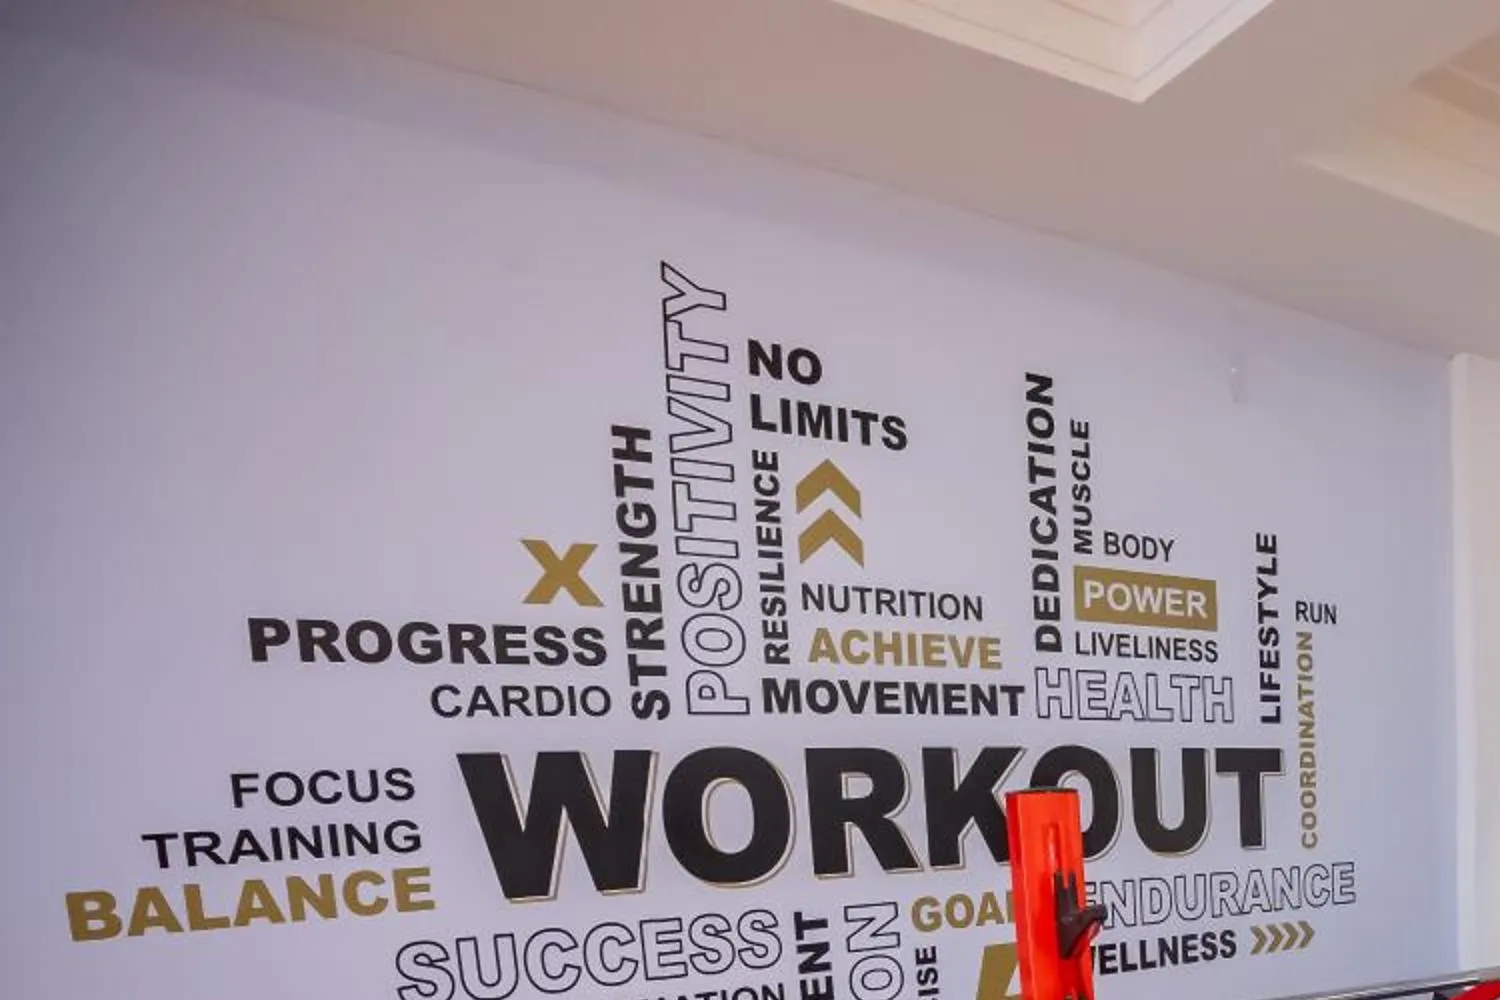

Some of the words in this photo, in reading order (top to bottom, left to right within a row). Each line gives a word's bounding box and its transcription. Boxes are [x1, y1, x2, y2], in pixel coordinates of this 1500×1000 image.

[748, 339, 823, 385] NO
[750, 393, 907, 451] LIMITS
[660, 260, 750, 715] POSITIVITY
[1070, 419, 1093, 555] MUSCLE
[1025, 372, 1063, 653] DEDICATION
[751, 449, 792, 665] RESILIENCE
[1104, 531, 1175, 562] BODY
[611, 424, 670, 720] STRENGTH
[801, 583, 985, 621] NUTRITION
[1083, 579, 1208, 619] POWER
[1295, 600, 1337, 625] RUN
[247, 617, 607, 666] PROGRESS
[808, 628, 1002, 669] ACHIEVE
[1074, 632, 1219, 663] LIVELINESS
[1256, 532, 1281, 724] LIFESTYLE
[430, 684, 611, 718] CARDIO
[761, 677, 1025, 717] MOVEMENT
[1034, 667, 1235, 723] HEALTH
[1296, 631, 1319, 849] COORDINATION
[230, 768, 415, 809] FOCUS
[142, 819, 422, 869] TRAINING
[457, 745, 1284, 903] WORKOUT
[65, 867, 435, 941] BALANCE
[1091, 929, 1237, 976] ELLNESS
